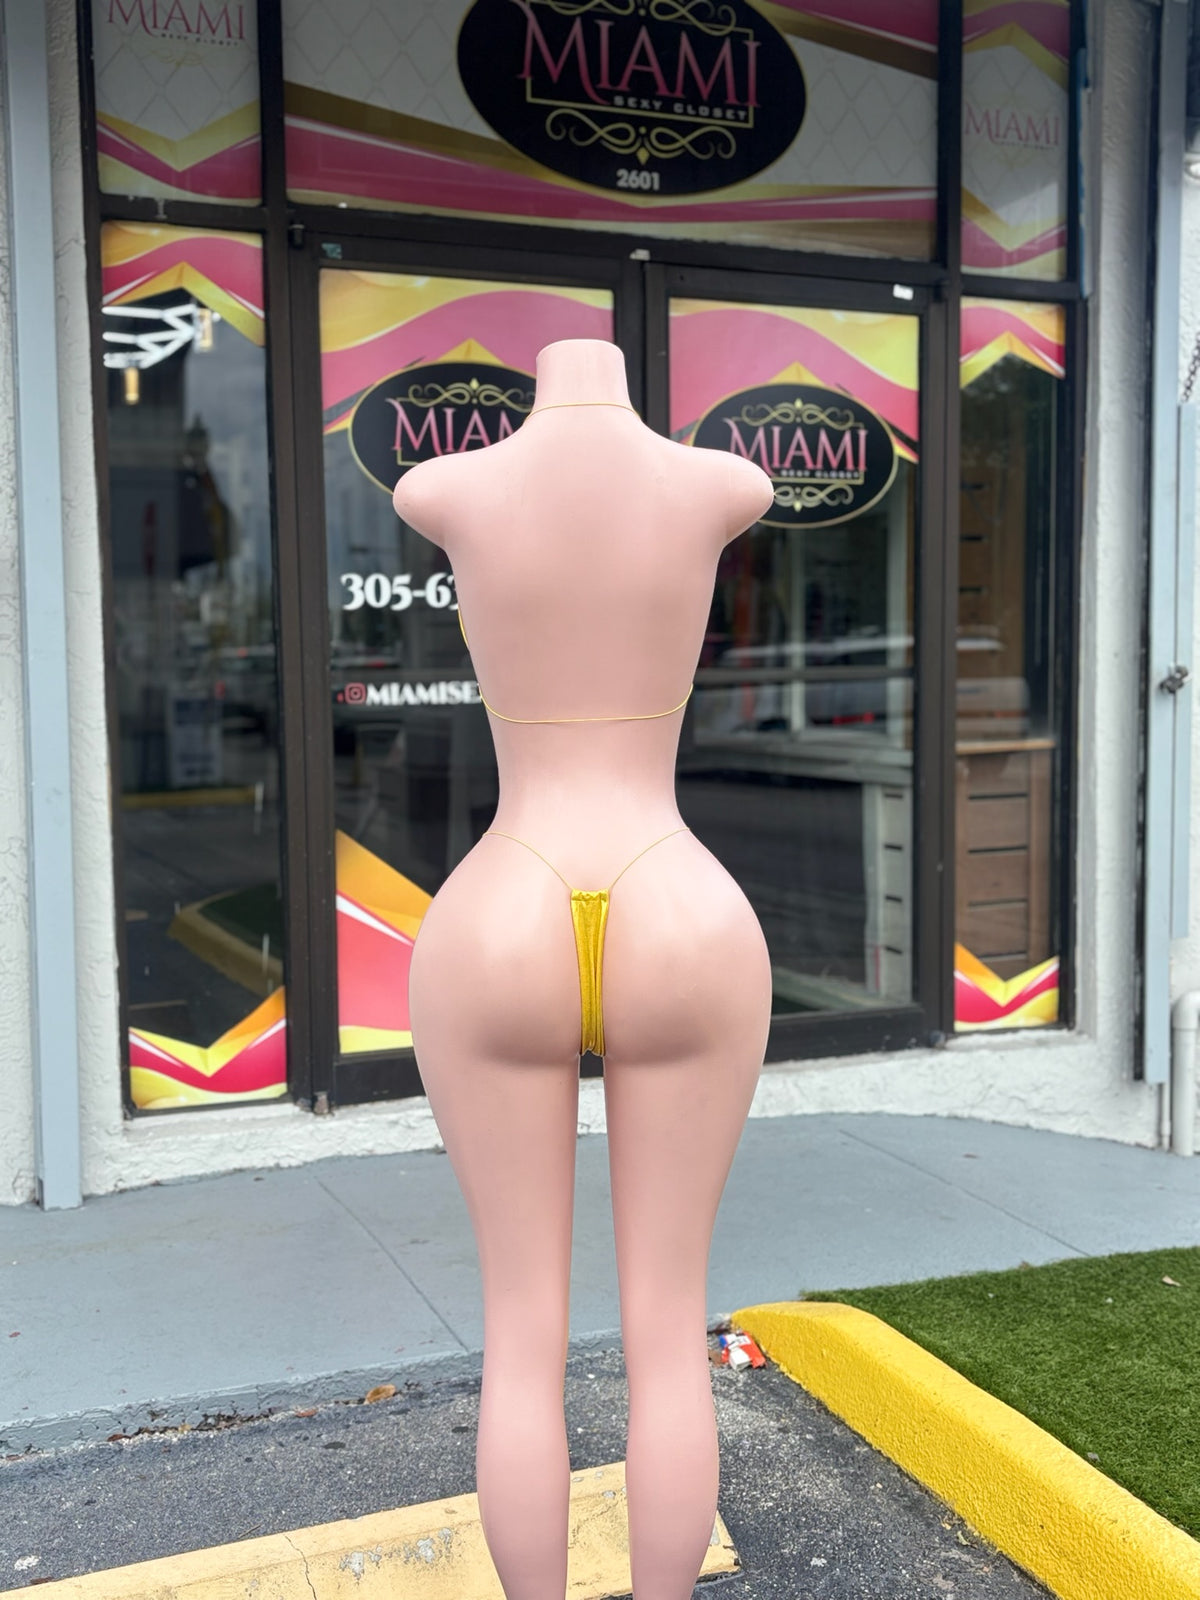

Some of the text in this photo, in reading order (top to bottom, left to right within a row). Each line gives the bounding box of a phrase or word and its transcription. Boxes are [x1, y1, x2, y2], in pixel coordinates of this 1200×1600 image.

[107, 0, 246, 40] MIAMI
[510, 0, 761, 108] MIAMI
[613, 95, 748, 121] SEXY CLOSET
[963, 100, 1060, 147] MIAMI
[616, 168, 661, 192] 2601
[723, 417, 869, 478] MIAMI
